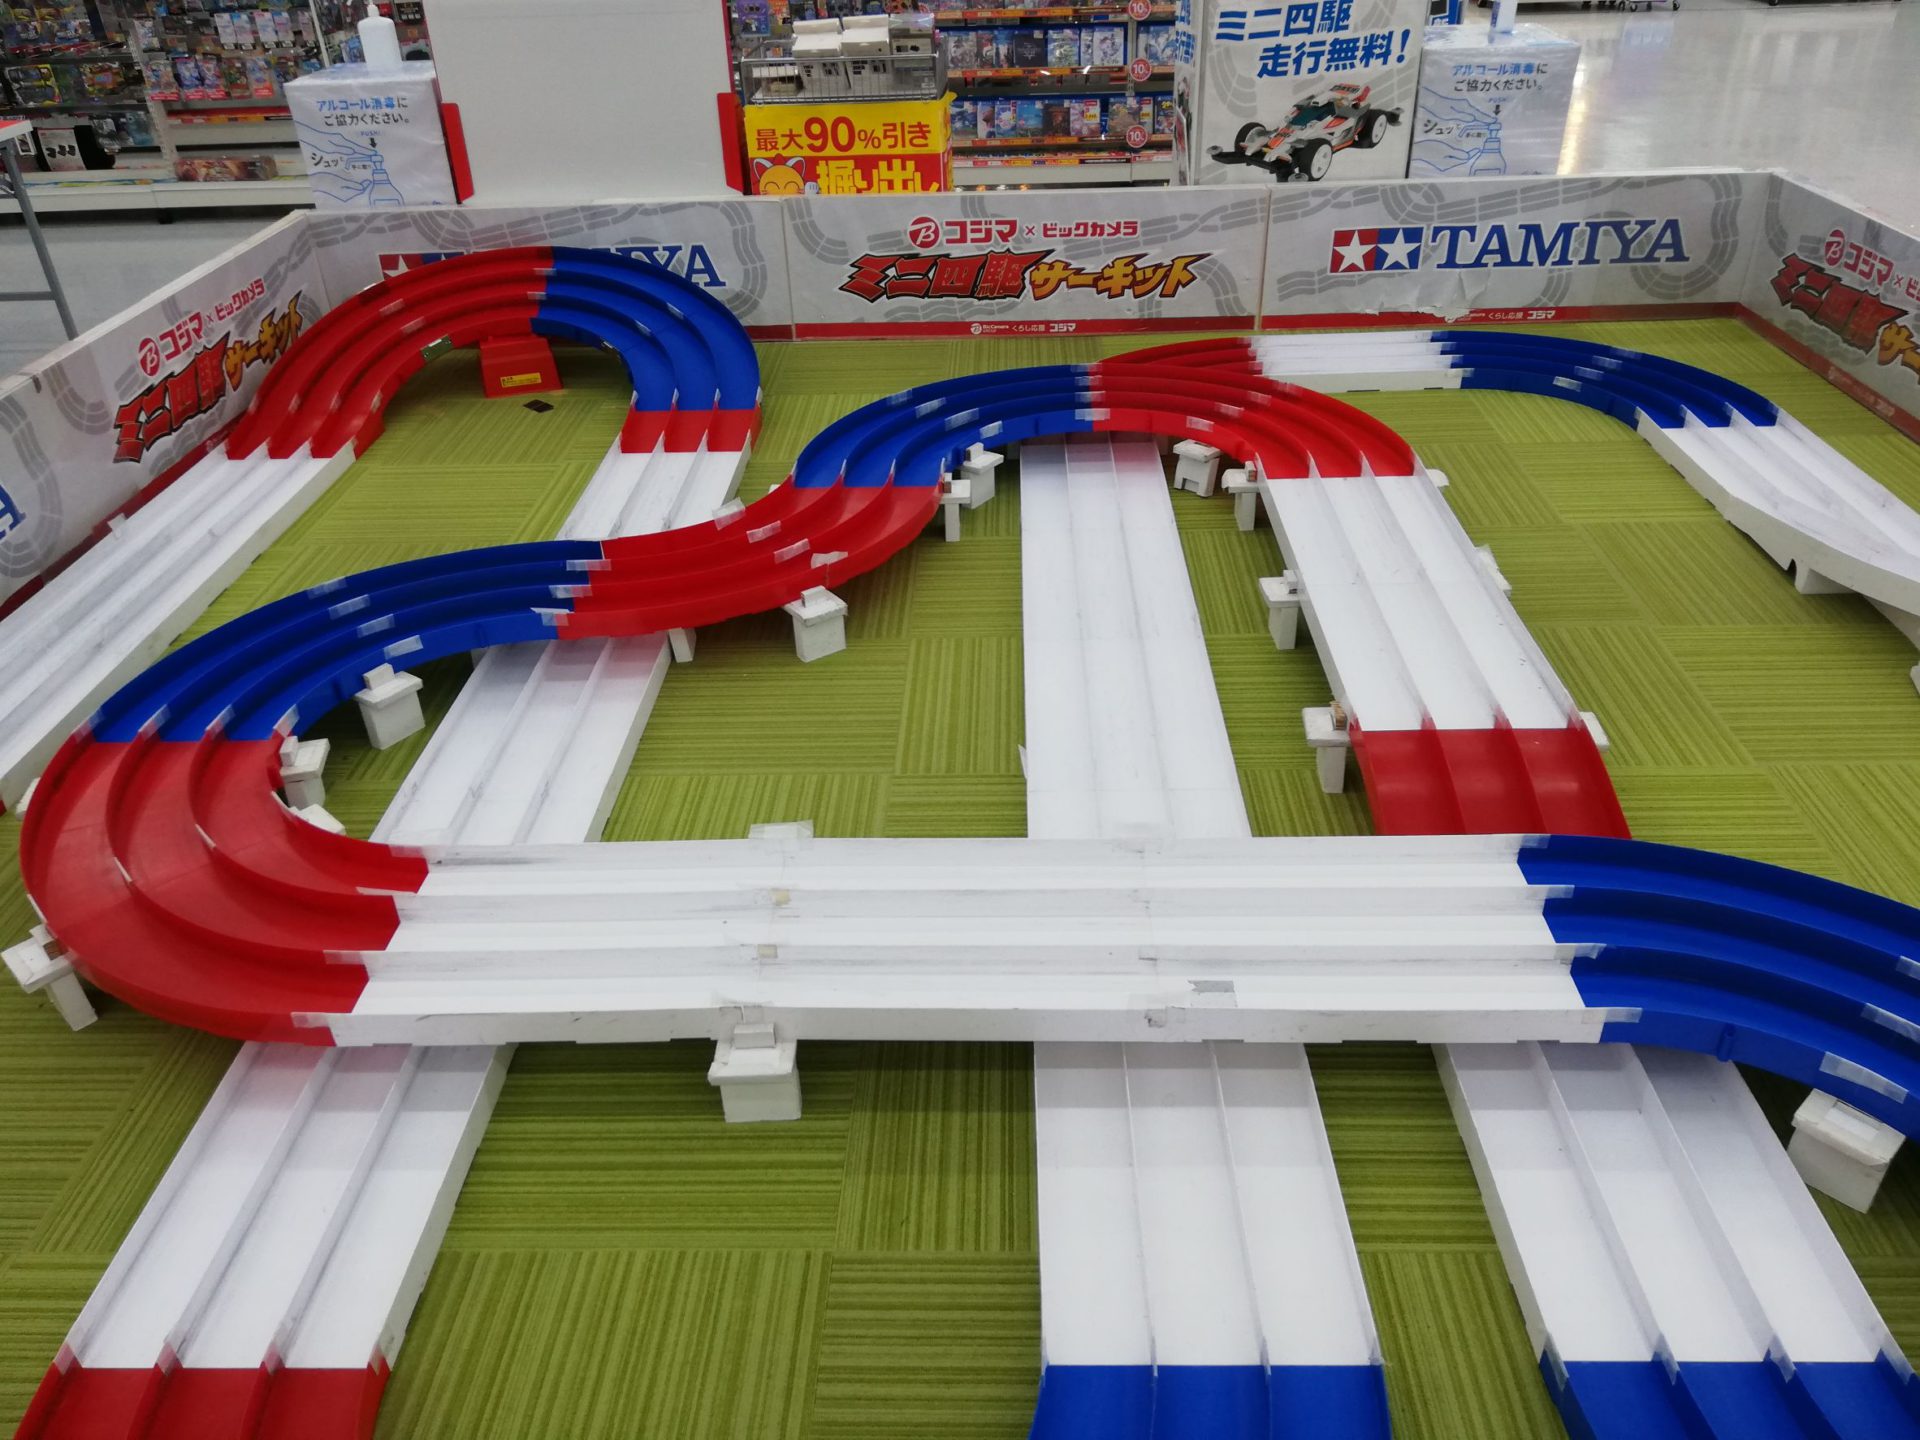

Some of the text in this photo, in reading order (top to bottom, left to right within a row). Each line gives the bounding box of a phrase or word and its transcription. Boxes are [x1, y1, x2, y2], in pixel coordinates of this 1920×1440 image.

[1215, 0, 1353, 41] ミニ四駆
[1257, 28, 1411, 79] 走行無料!
[1452, 62, 1548, 76] アルコール消毒に
[1454, 79, 1543, 92] ご協力ください。
[316, 97, 408, 111] アルコール消毒に
[324, 113, 410, 127] ご協力ください。
[756, 116, 931, 153] 最大90%引き
[945, 219, 1018, 244] コジマ
[1042, 220, 1139, 238] ビックカメラ
[1431, 218, 1690, 270] TAMIYA
[1843, 242, 1894, 287] コジマ
[159, 312, 203, 360] コジマ
[215, 278, 265, 320] ビックカメラ
[1050, 323, 1076, 332] コジマ
